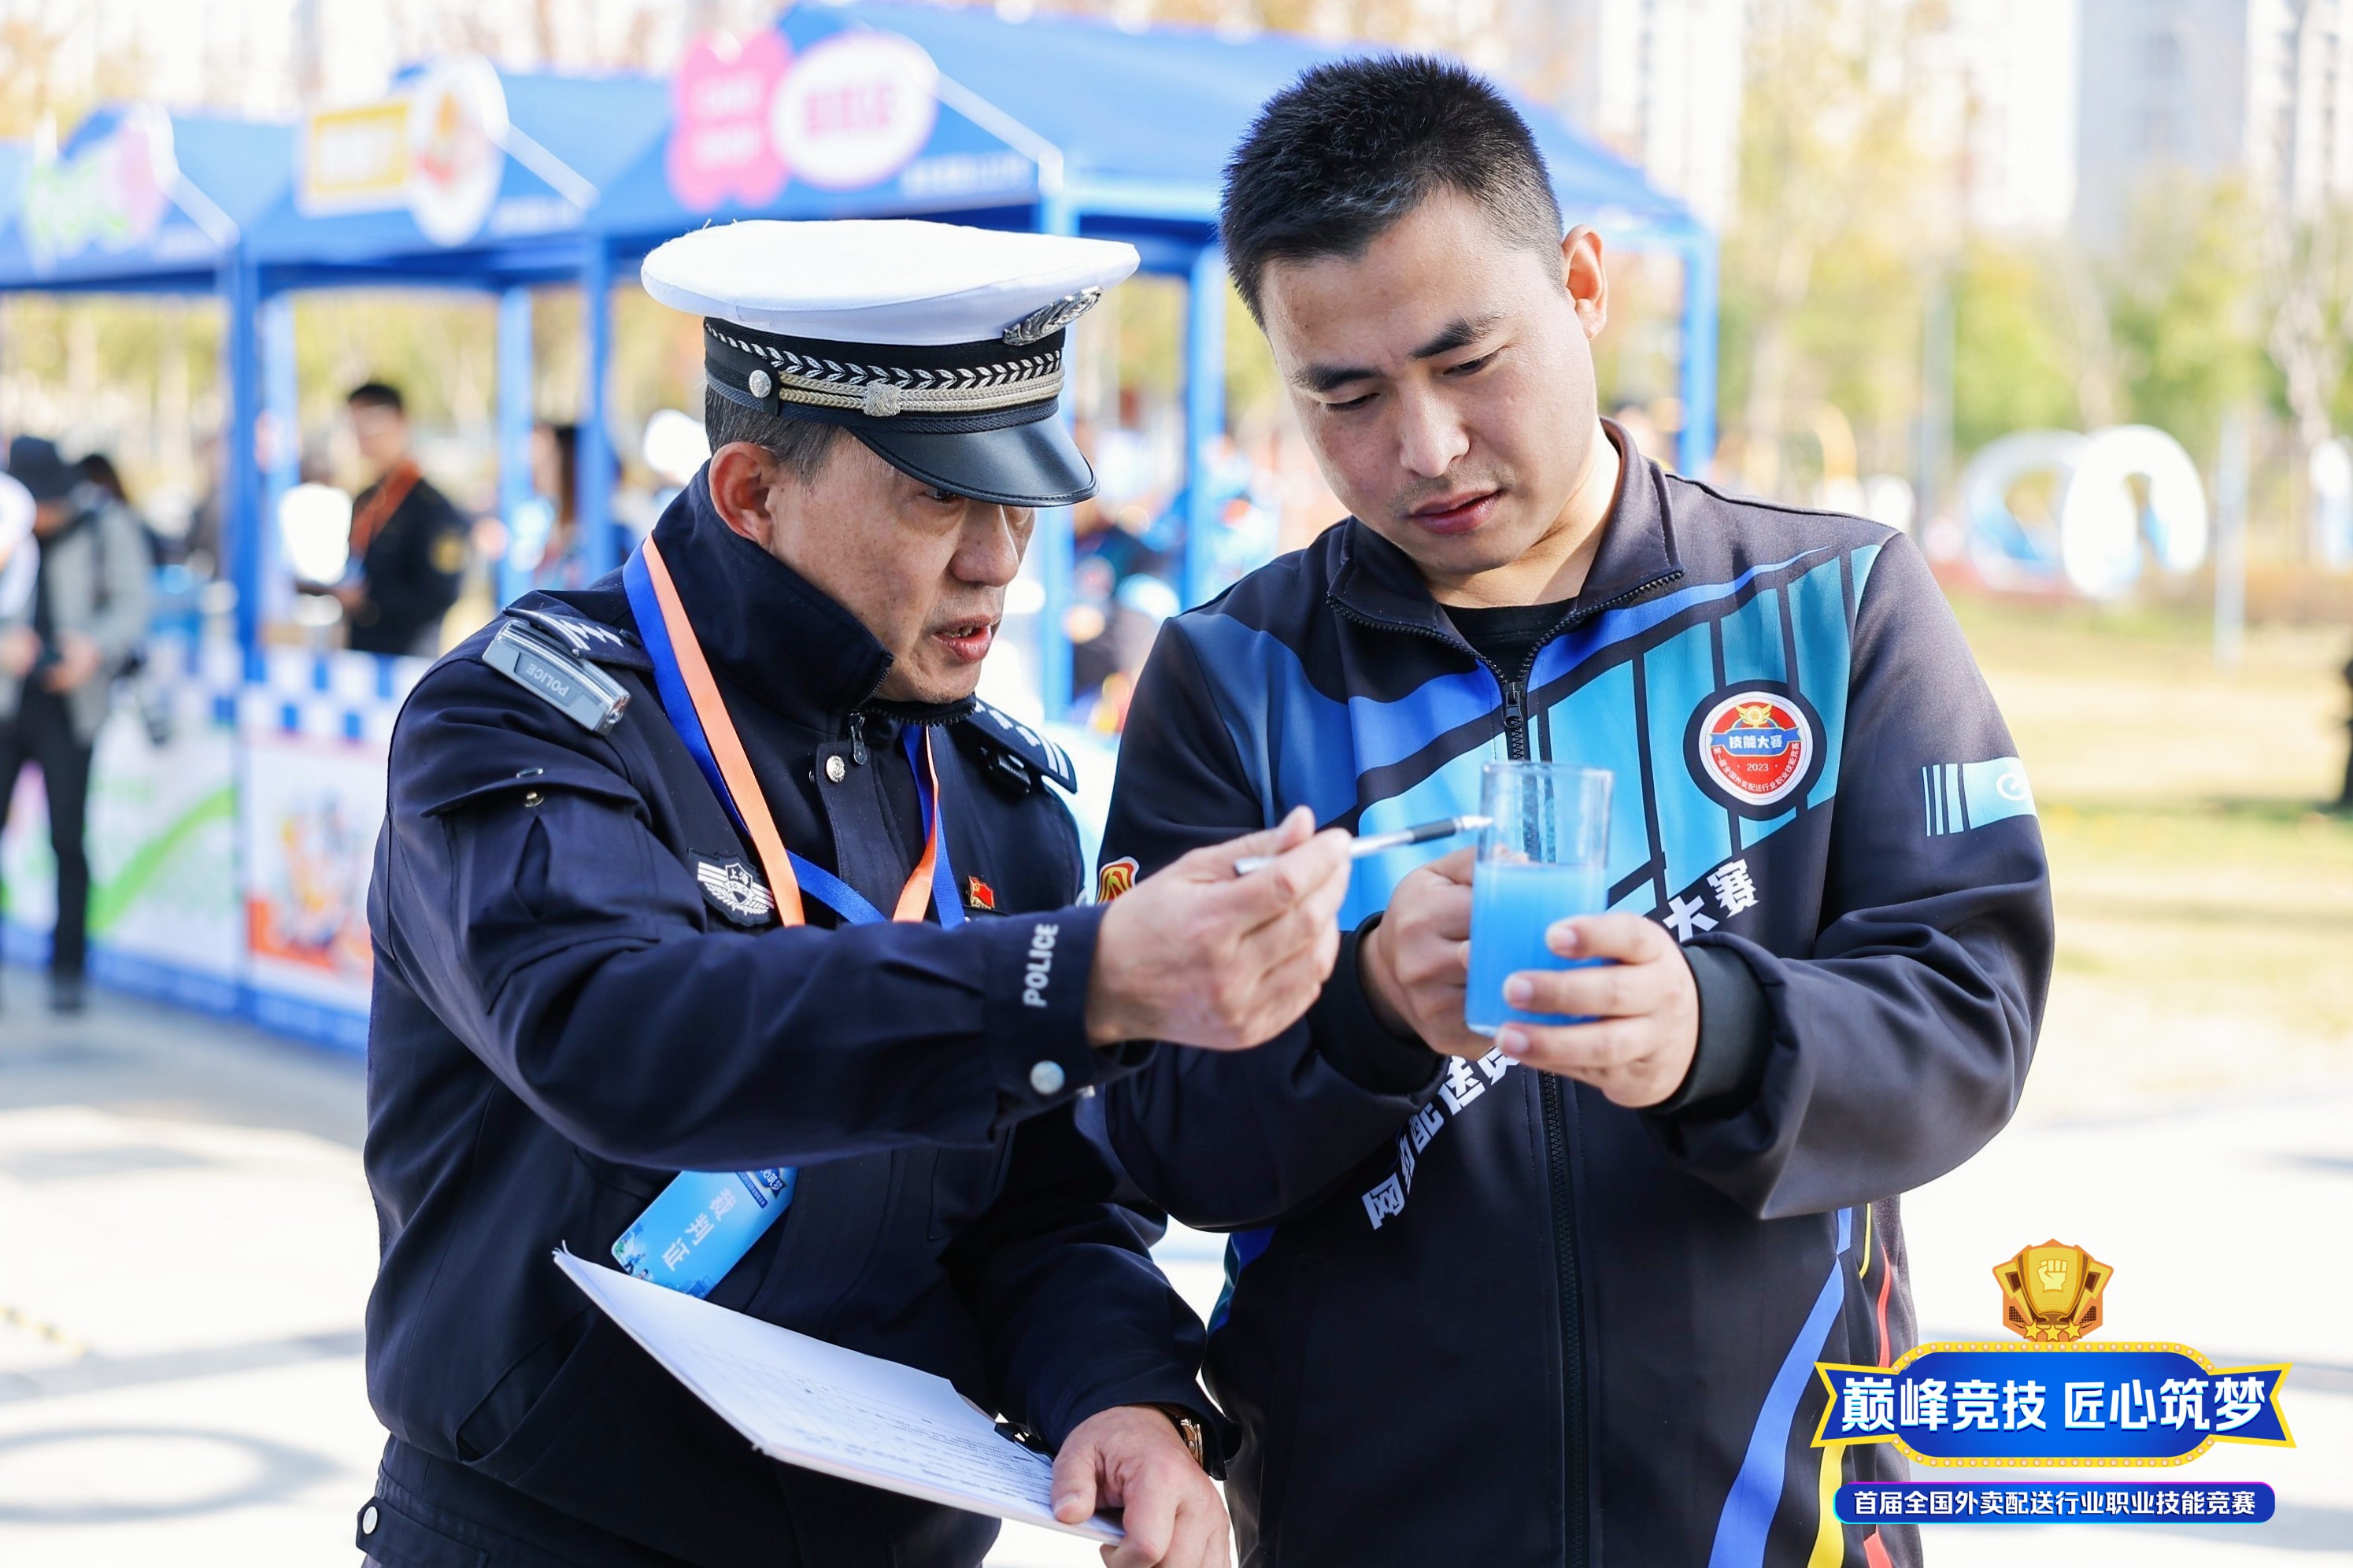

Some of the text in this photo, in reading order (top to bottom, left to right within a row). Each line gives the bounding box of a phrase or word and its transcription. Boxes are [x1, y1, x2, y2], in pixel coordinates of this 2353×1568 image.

[525, 663, 570, 697] POLICE
[1728, 734, 1783, 749] 技能大赛
[1746, 763, 1769, 771] 2023
[729, 868, 749, 886] 上海
[728, 882, 750, 896] POLICE
[1662, 858, 1759, 943] 大赛
[1023, 923, 1060, 1008] POLICE
[758, 1169, 783, 1191] 心筑梦
[661, 1187, 738, 1272] 裁判证
